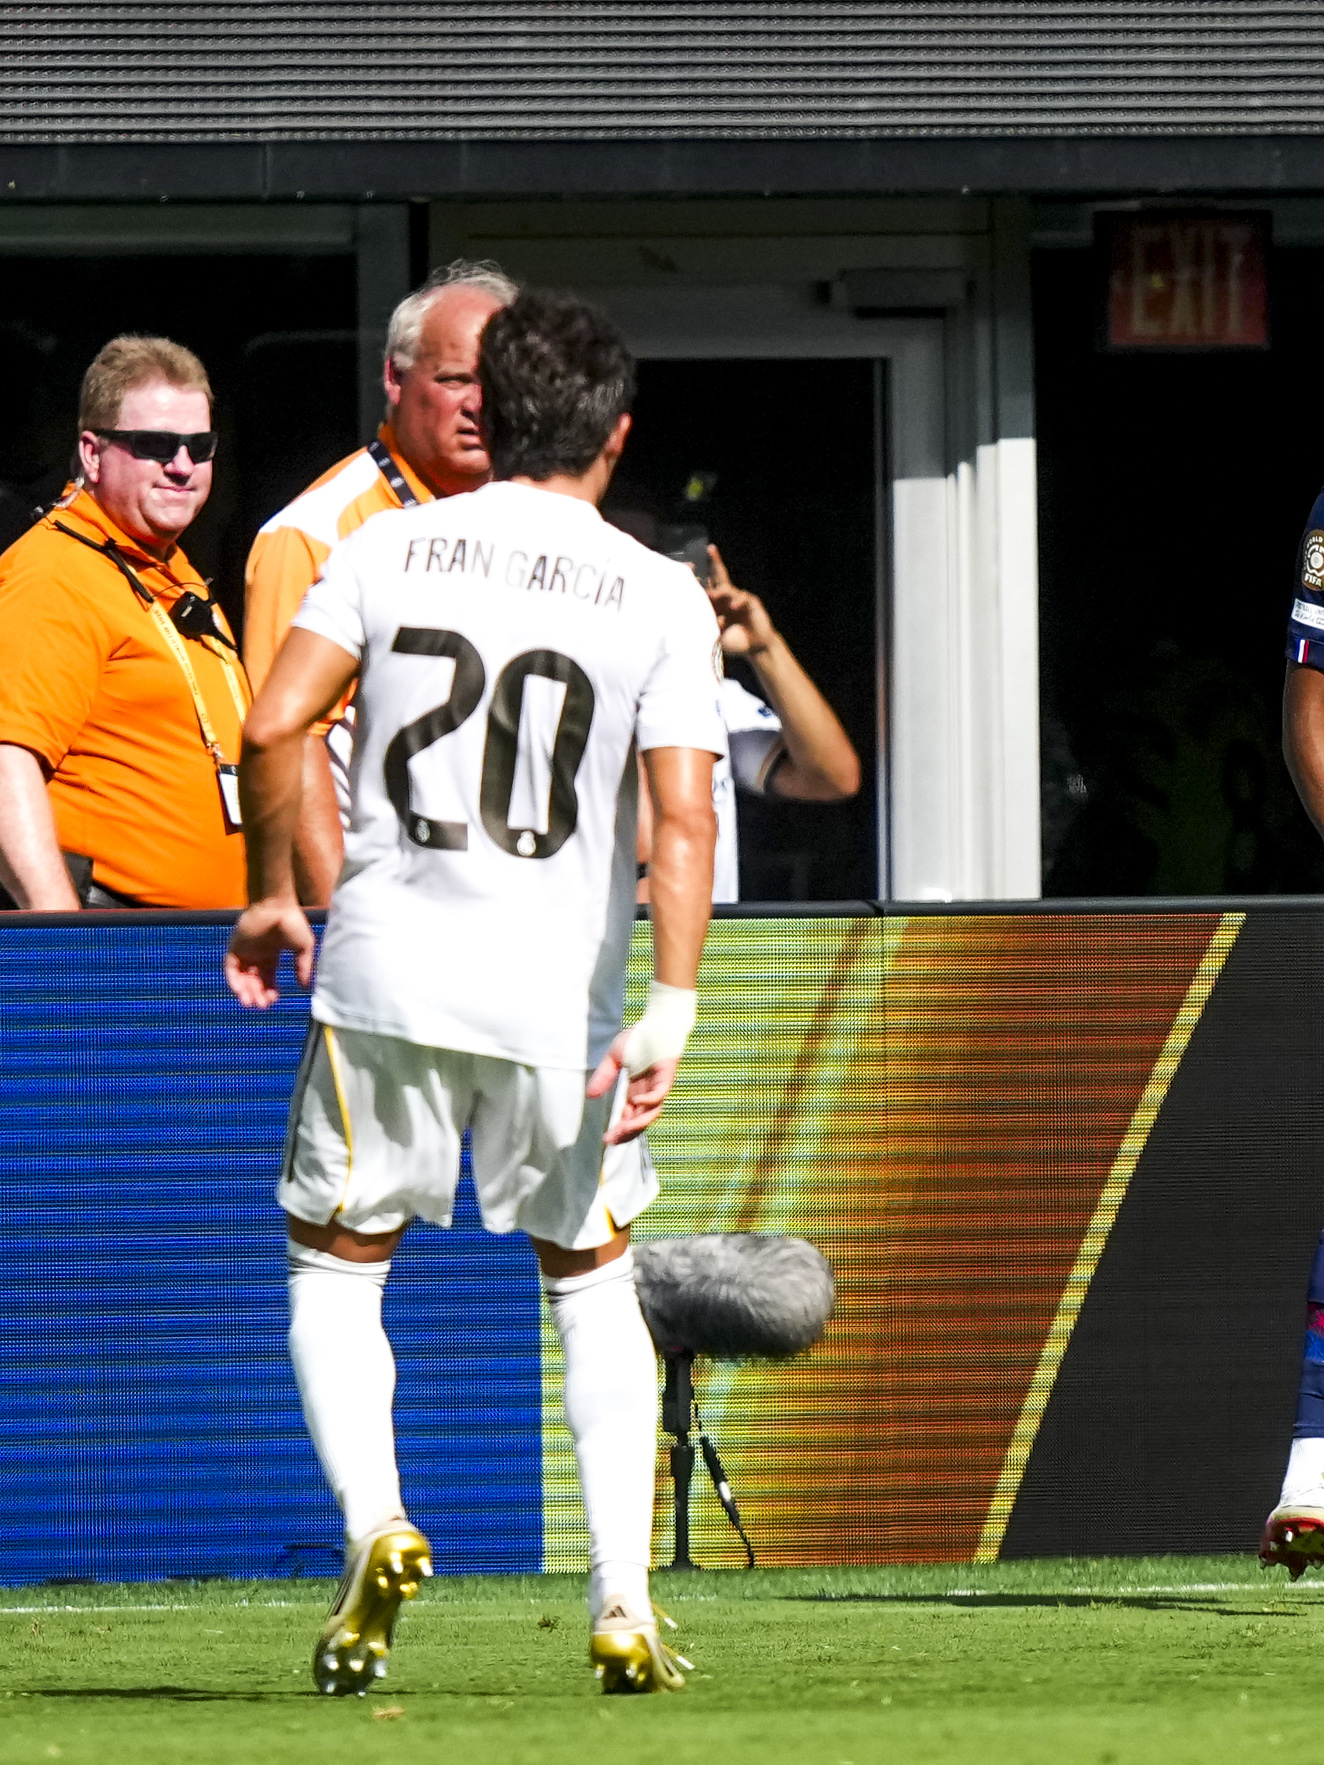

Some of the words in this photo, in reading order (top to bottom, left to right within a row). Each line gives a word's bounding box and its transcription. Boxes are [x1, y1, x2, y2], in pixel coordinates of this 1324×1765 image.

[1130, 222, 1252, 336] EXIT
[403, 537, 496, 579] FRAN
[504, 546, 625, 612] GARCÍA
[1304, 573, 1323, 587] FIFA
[384, 626, 595, 859] 20
